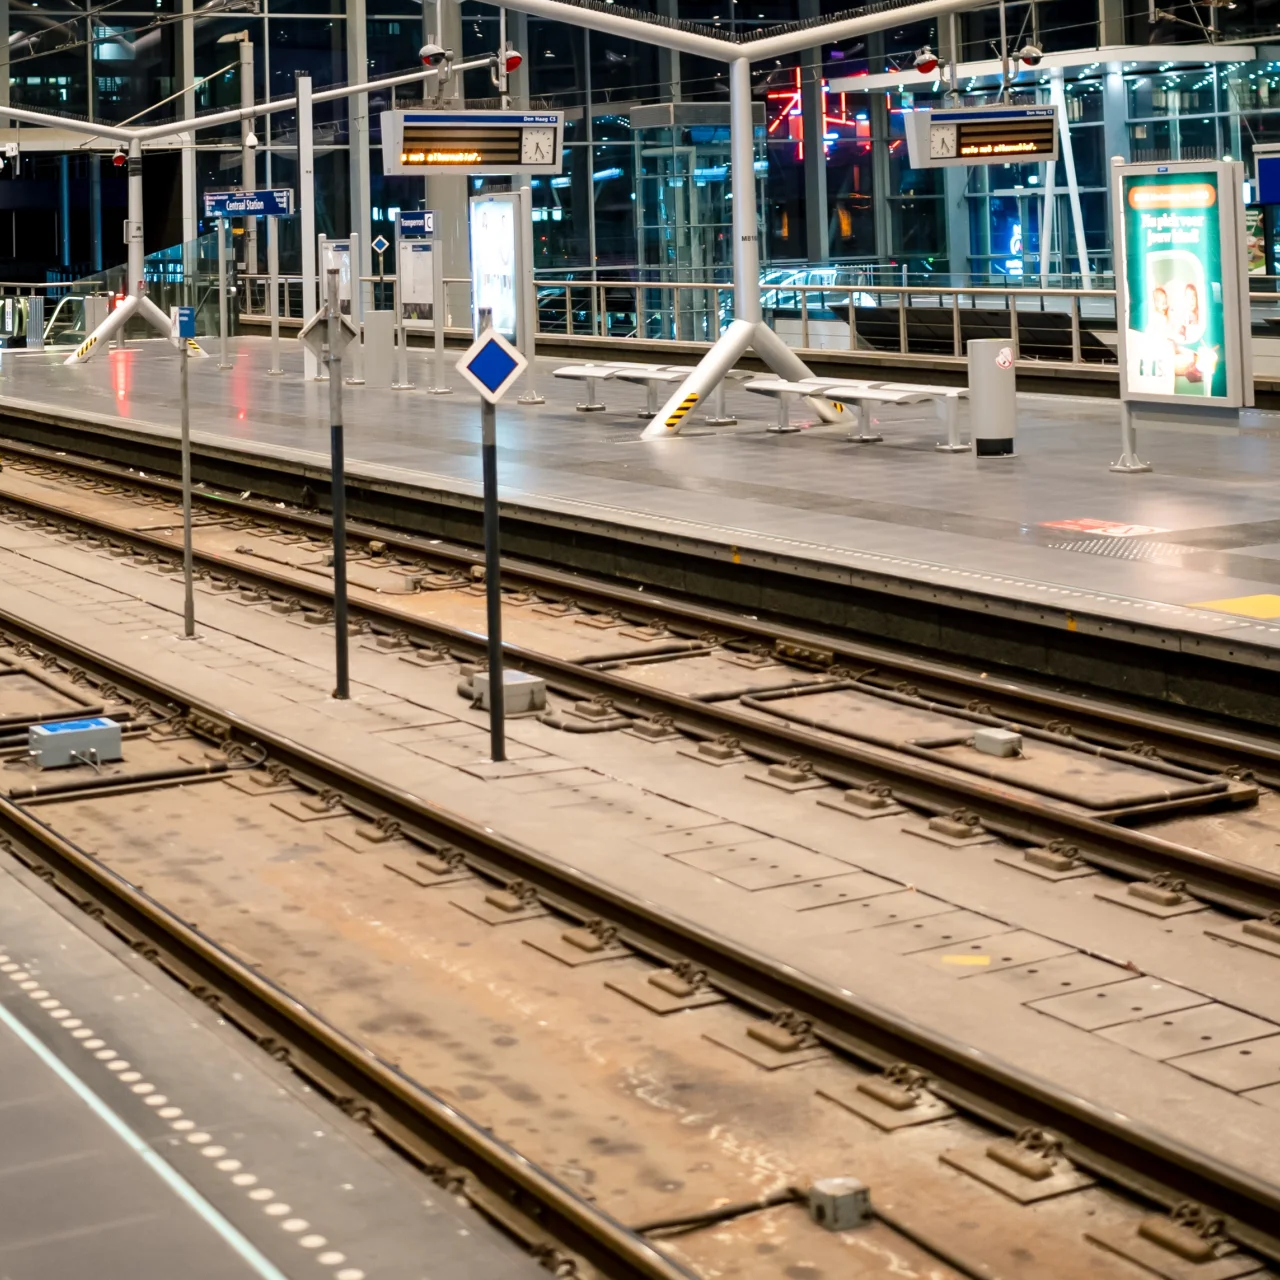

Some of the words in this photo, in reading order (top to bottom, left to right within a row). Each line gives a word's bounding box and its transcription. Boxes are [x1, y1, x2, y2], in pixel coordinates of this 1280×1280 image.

[225, 199, 245, 211] Centraal
[246, 198, 265, 211] Station
[400, 218, 425, 229] Tramperron
